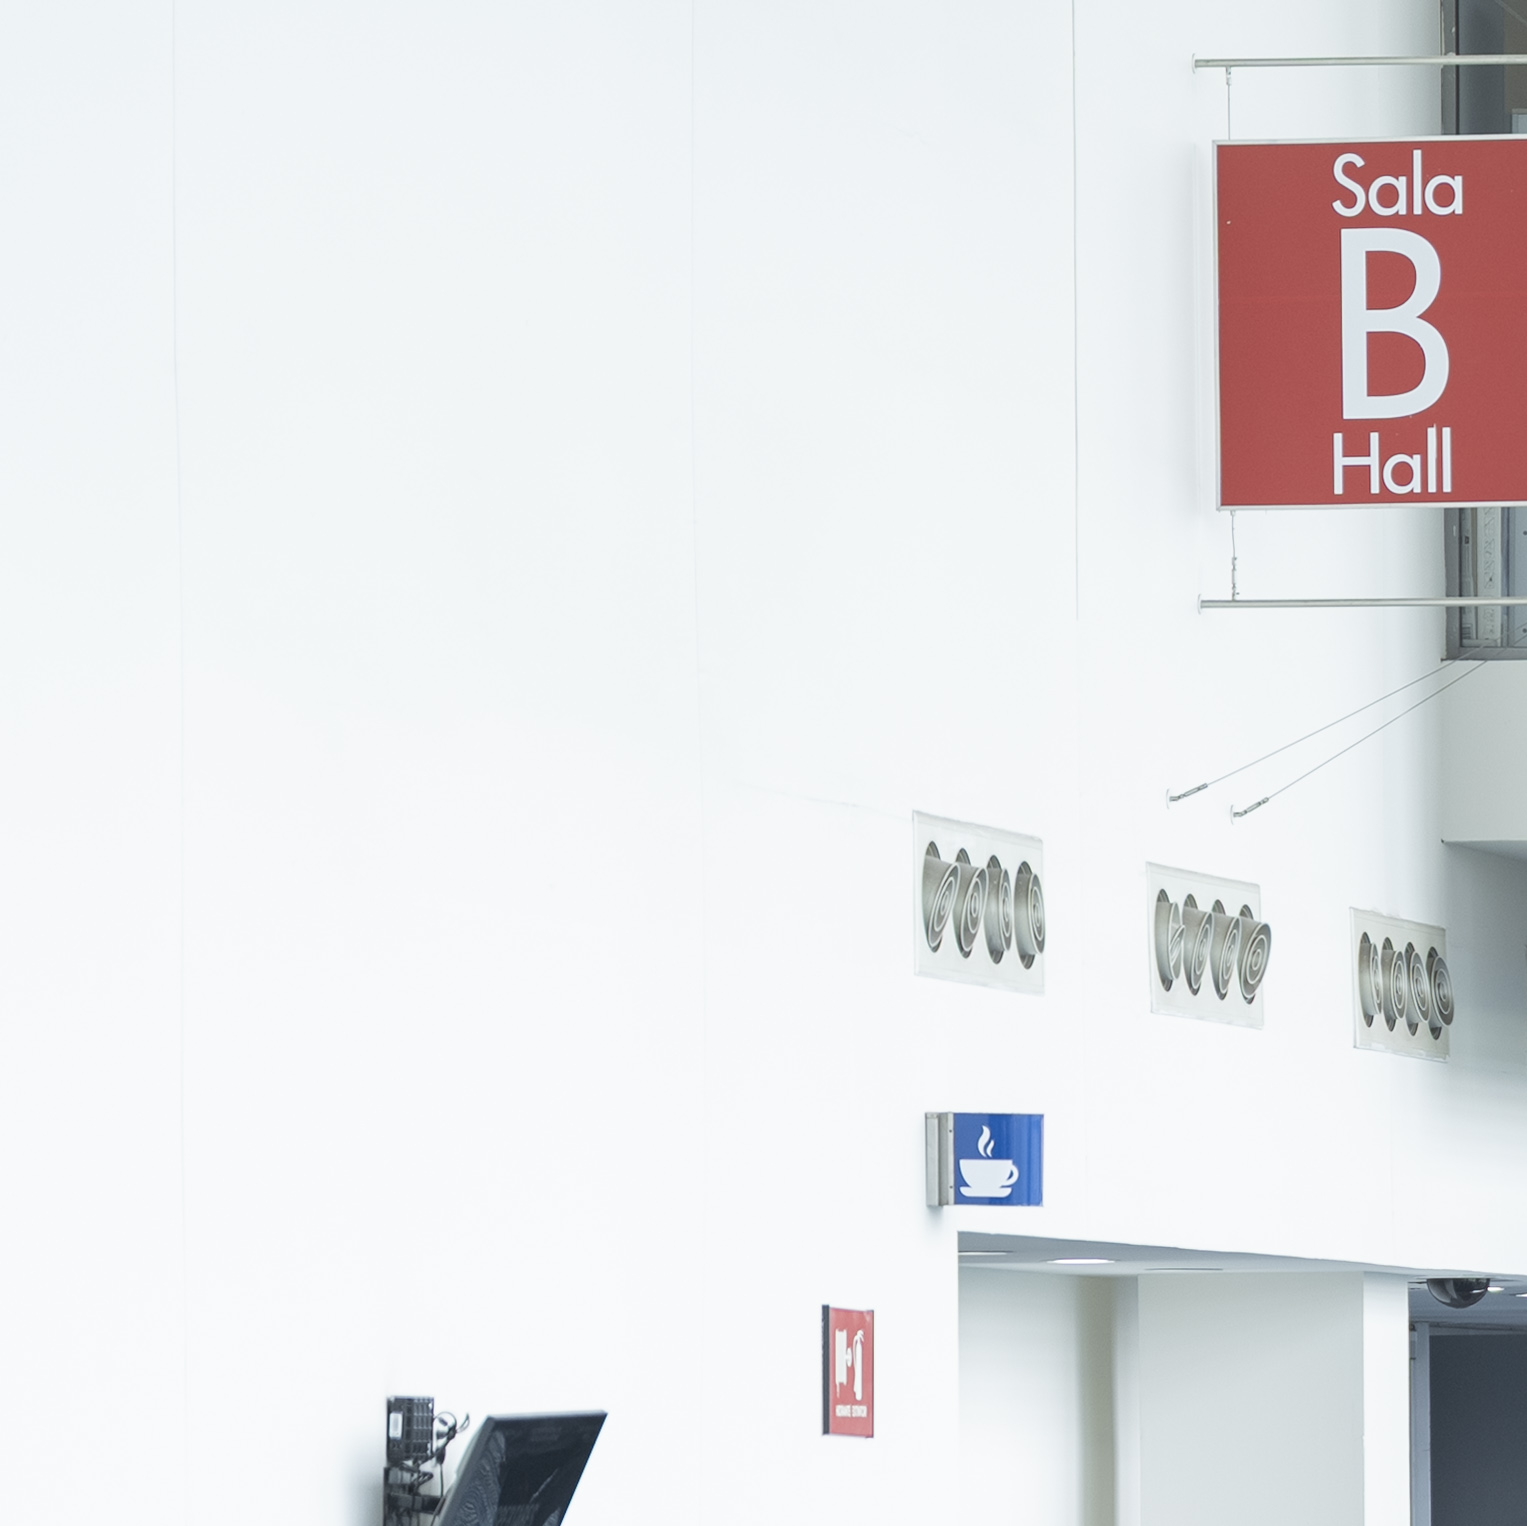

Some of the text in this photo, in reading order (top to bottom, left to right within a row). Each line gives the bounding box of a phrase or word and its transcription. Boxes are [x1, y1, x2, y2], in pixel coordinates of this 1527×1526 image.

[1331, 149, 1463, 217] Sala
[1340, 227, 1450, 420] B
[1333, 426, 1452, 494] Hall
